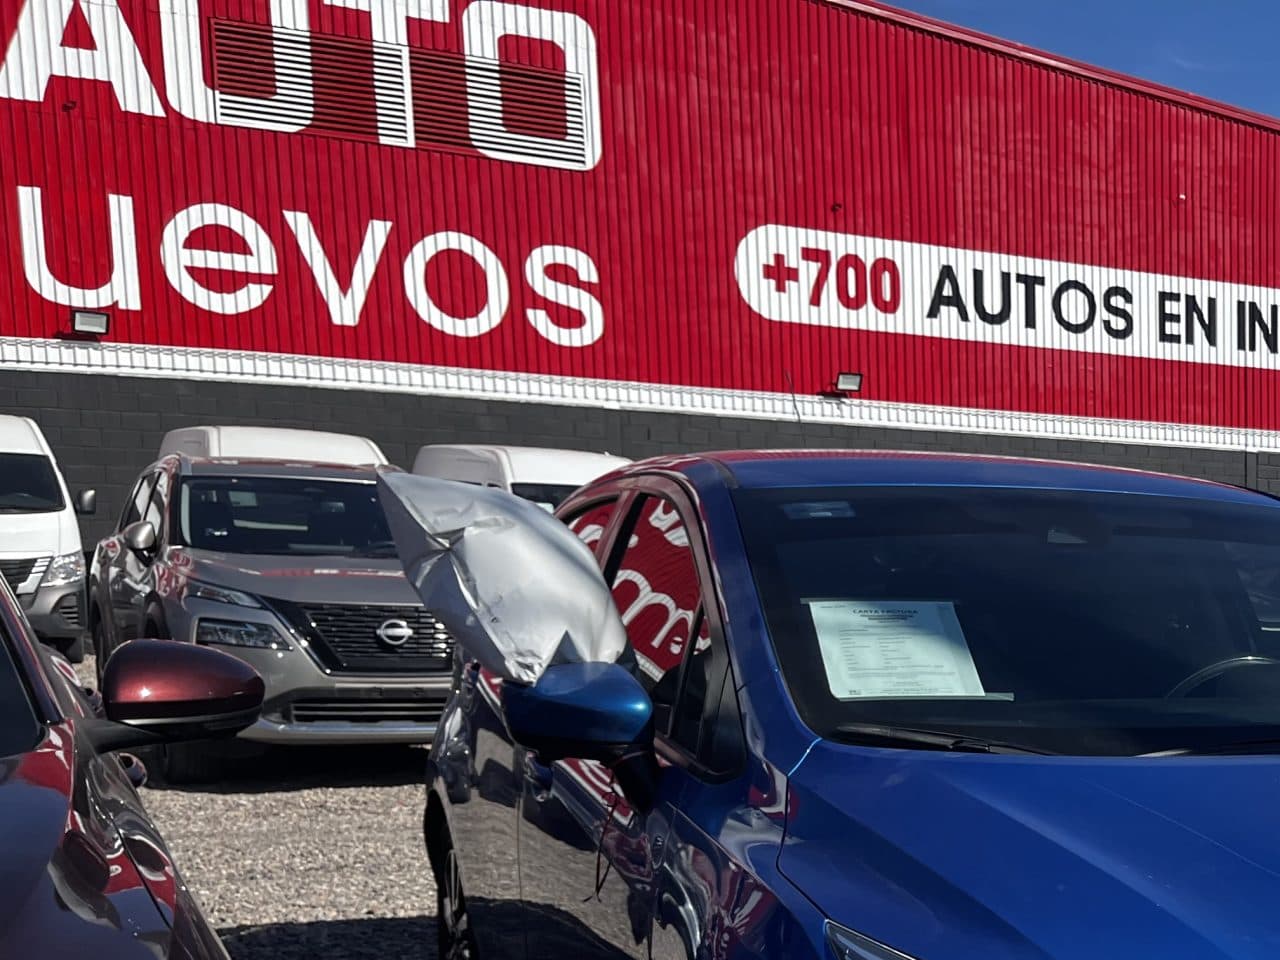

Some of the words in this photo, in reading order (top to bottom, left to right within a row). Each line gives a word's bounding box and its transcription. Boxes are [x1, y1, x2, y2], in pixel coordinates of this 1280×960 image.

[0, 0, 602, 170] AUTO
[16, 185, 604, 347] uevos
[762, 246, 901, 314] +700
[926, 264, 1134, 340] AUTOS
[1158, 290, 1217, 348] EN
